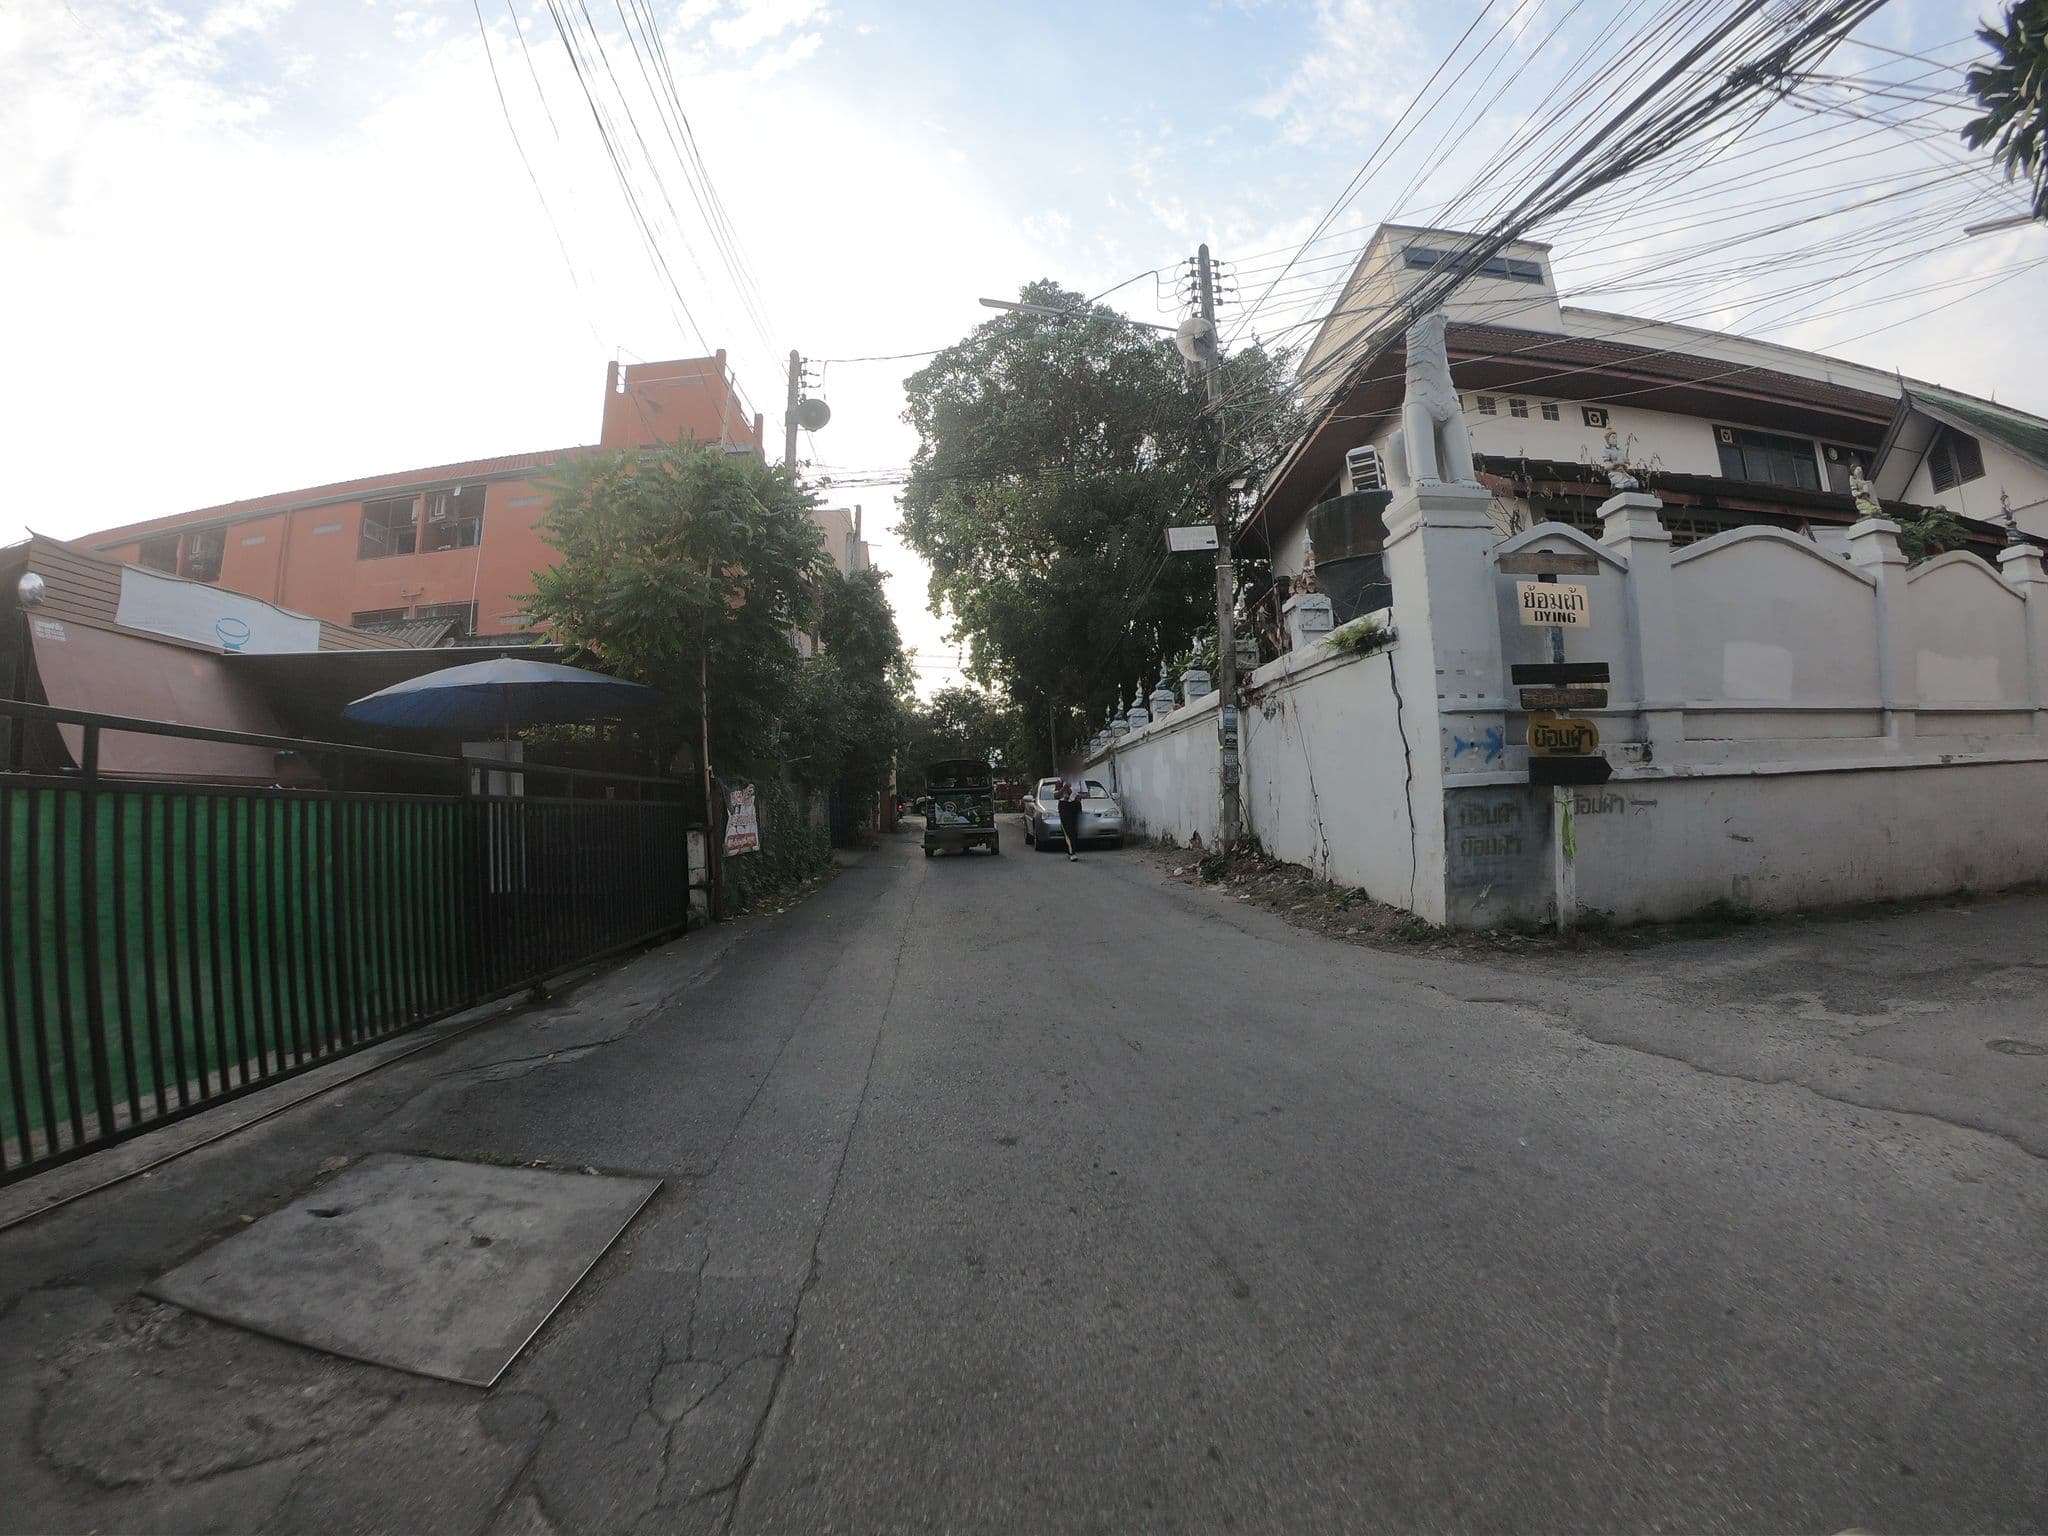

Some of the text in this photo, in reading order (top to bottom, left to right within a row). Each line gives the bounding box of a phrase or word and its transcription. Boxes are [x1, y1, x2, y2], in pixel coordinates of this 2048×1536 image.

[1524, 584, 1584, 611] ย้อมผ้า
[1534, 611, 1577, 623] DYING
[1534, 724, 1594, 747] ย้อมผ้า
